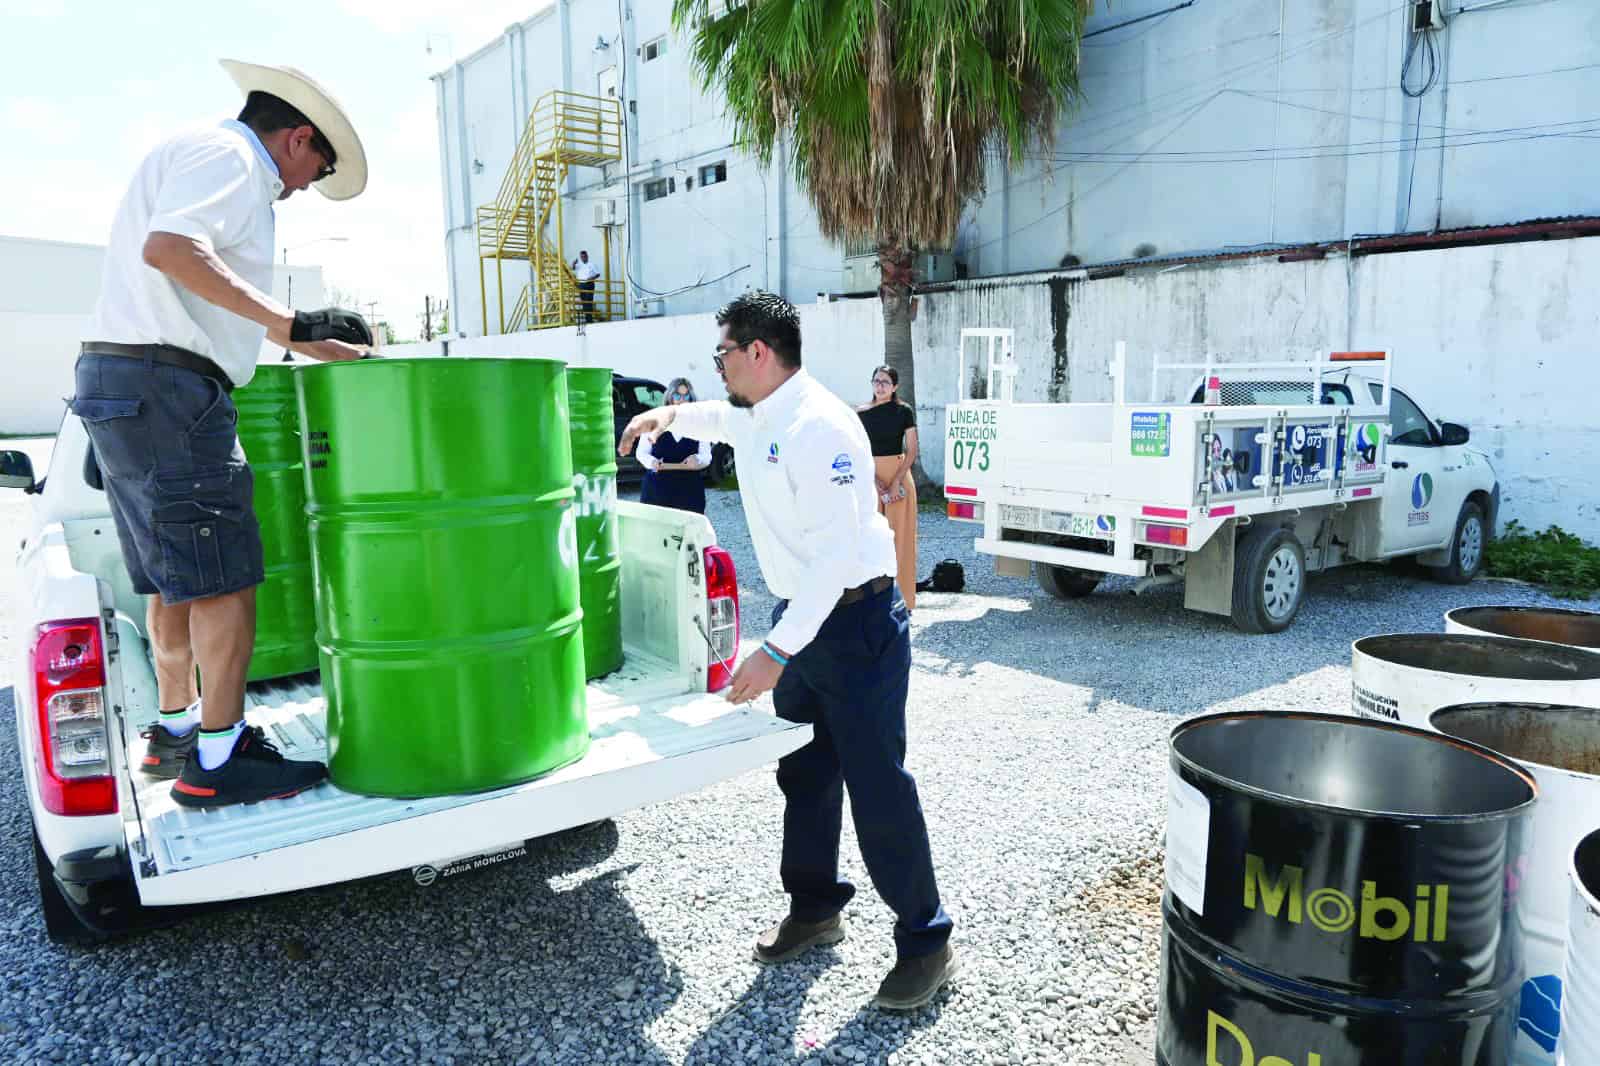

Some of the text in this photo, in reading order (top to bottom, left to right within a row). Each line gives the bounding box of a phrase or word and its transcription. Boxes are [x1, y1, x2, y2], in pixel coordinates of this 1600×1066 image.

[982, 410, 997, 425] DE
[1306, 436, 1322, 449] 073
[953, 439, 990, 471] 073
[473, 847, 527, 869] MONCLOVA
[1243, 852, 1449, 942] Mobil
